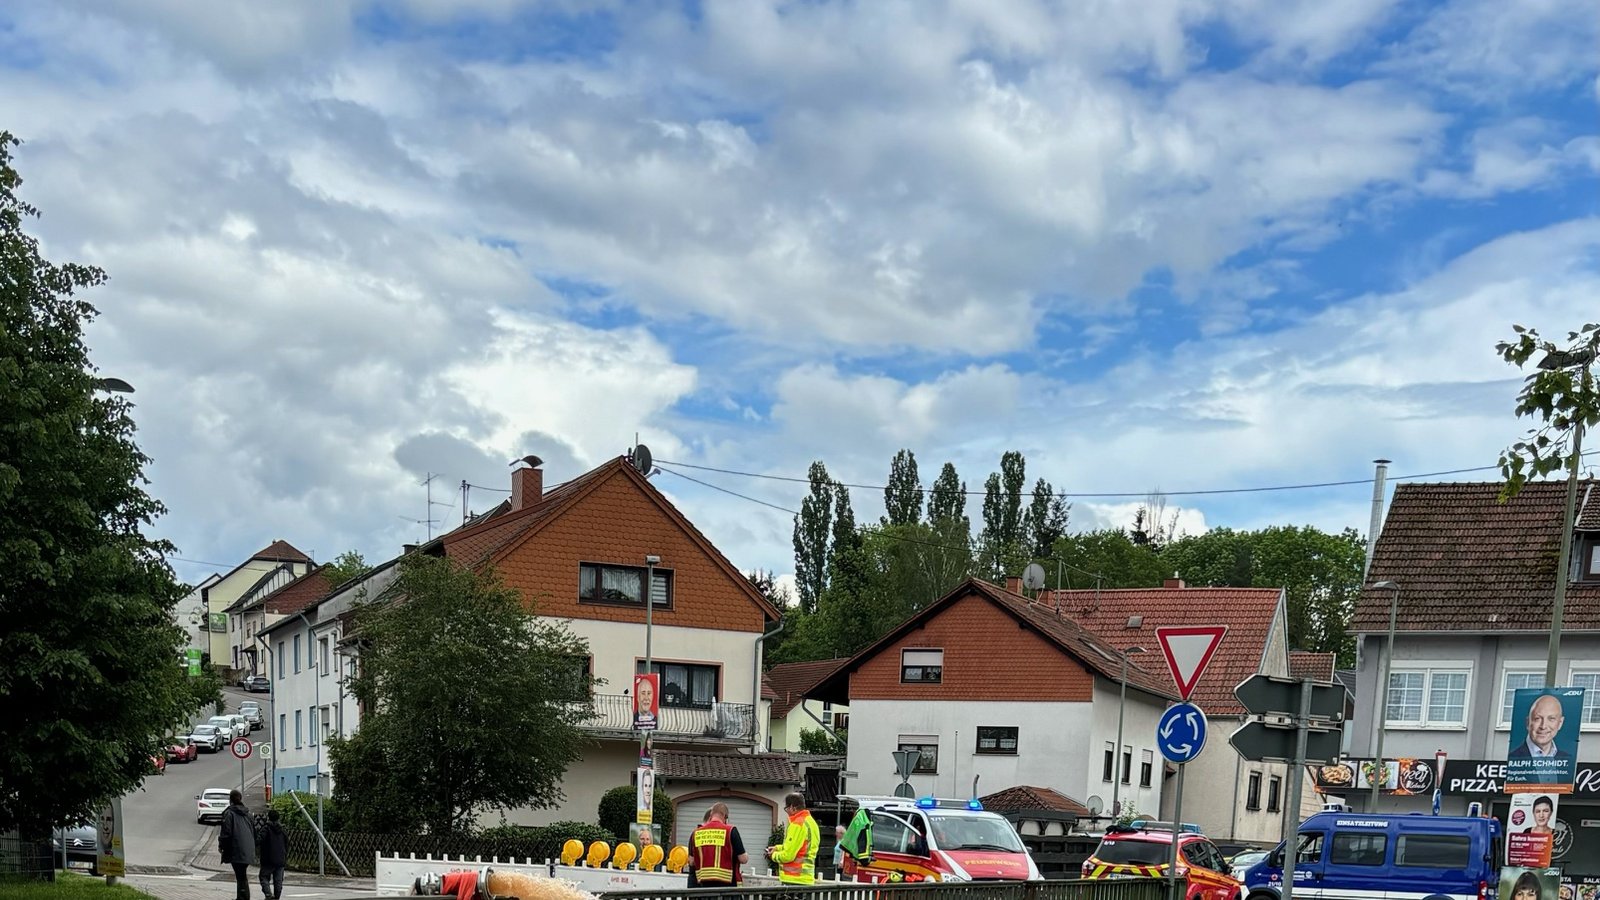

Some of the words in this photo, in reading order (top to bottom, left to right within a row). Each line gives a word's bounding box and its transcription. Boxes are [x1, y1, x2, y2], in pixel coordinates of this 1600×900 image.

[235, 743, 248, 754] 30
[1336, 820, 1389, 828] EINSATZLEITUNG
[964, 859, 1021, 867] FEUERWEHR
